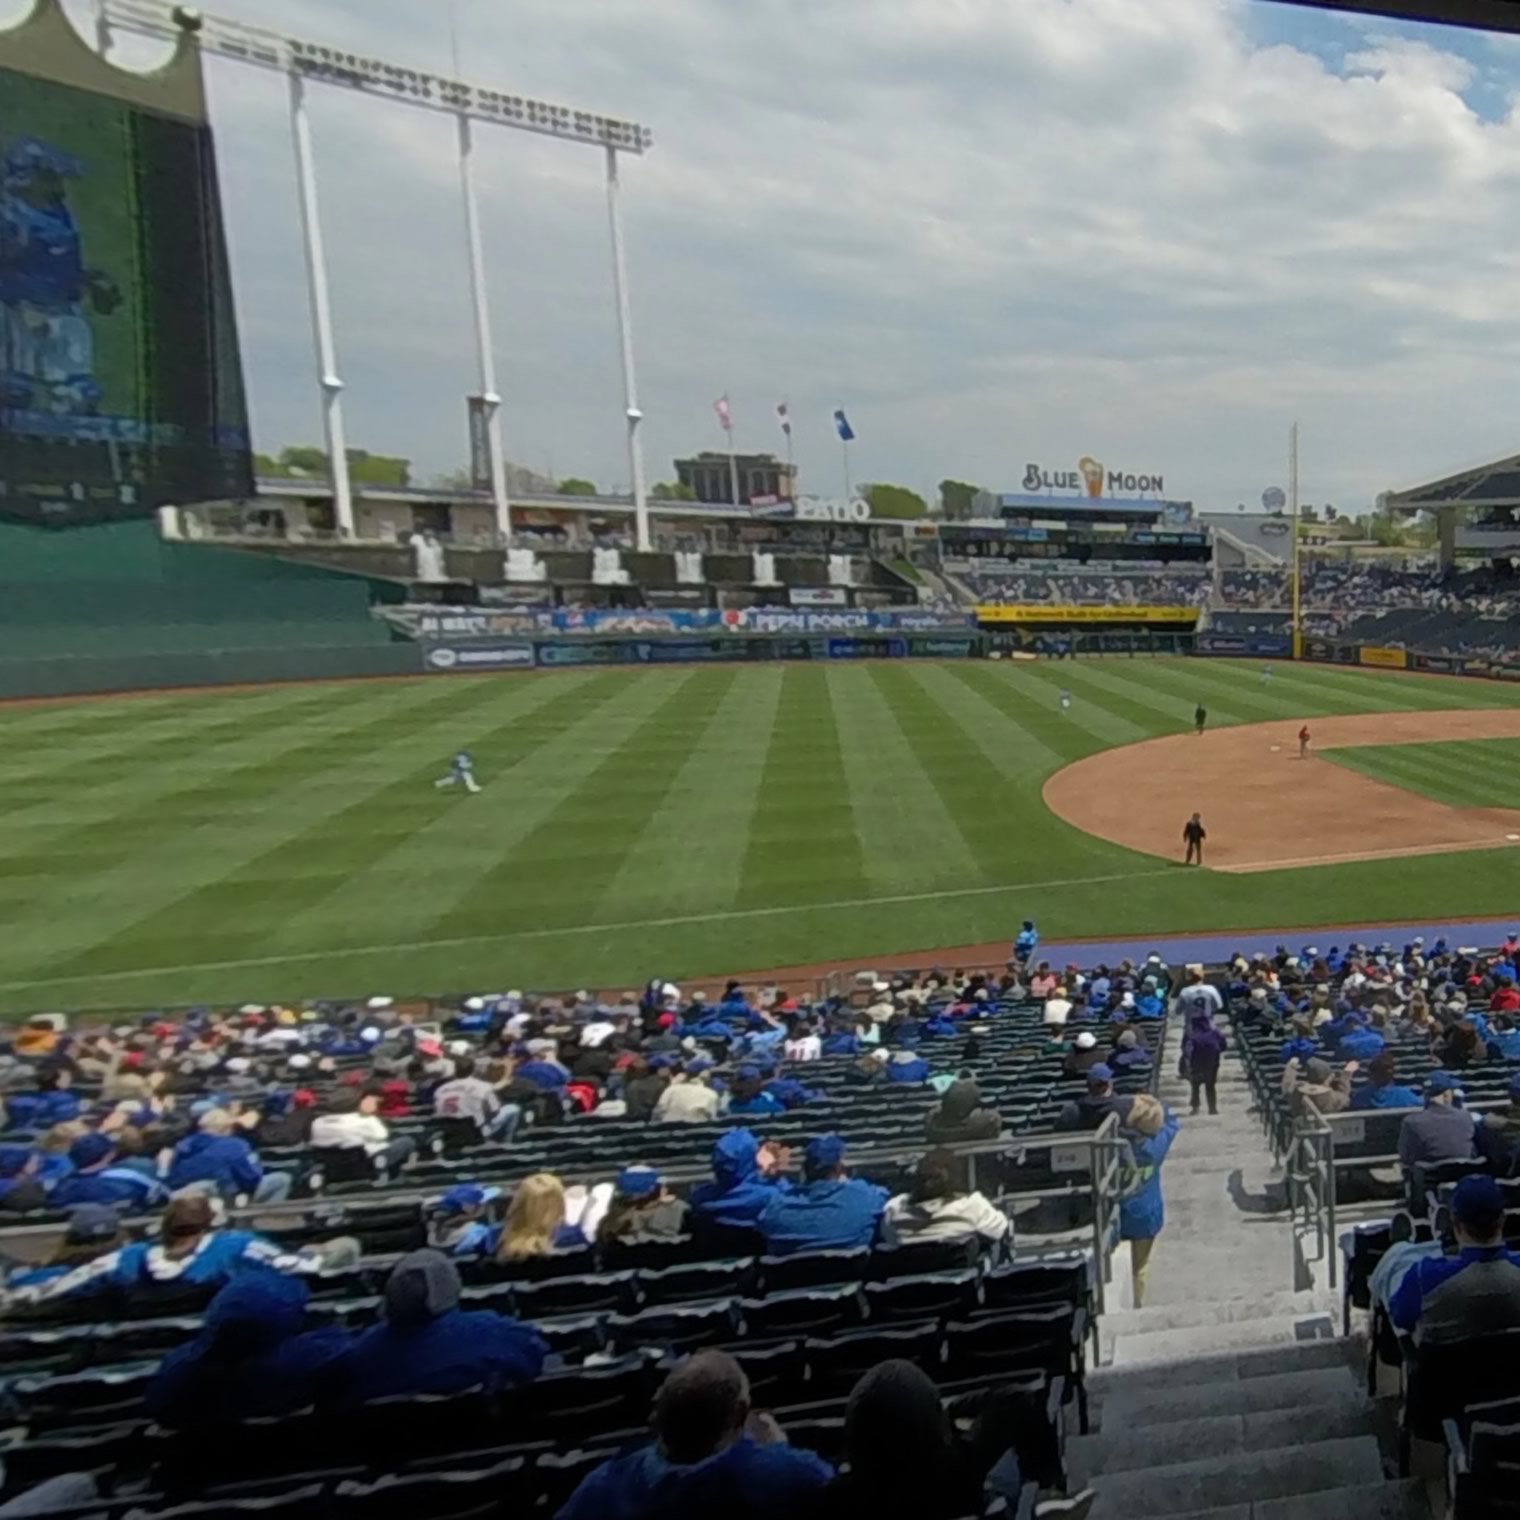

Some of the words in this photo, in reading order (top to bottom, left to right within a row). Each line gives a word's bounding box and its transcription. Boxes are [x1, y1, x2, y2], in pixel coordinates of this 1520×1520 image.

[1107, 471, 1163, 491] MOON
[756, 614, 804, 632] PEPSI
[807, 613, 869, 632] PORCH
